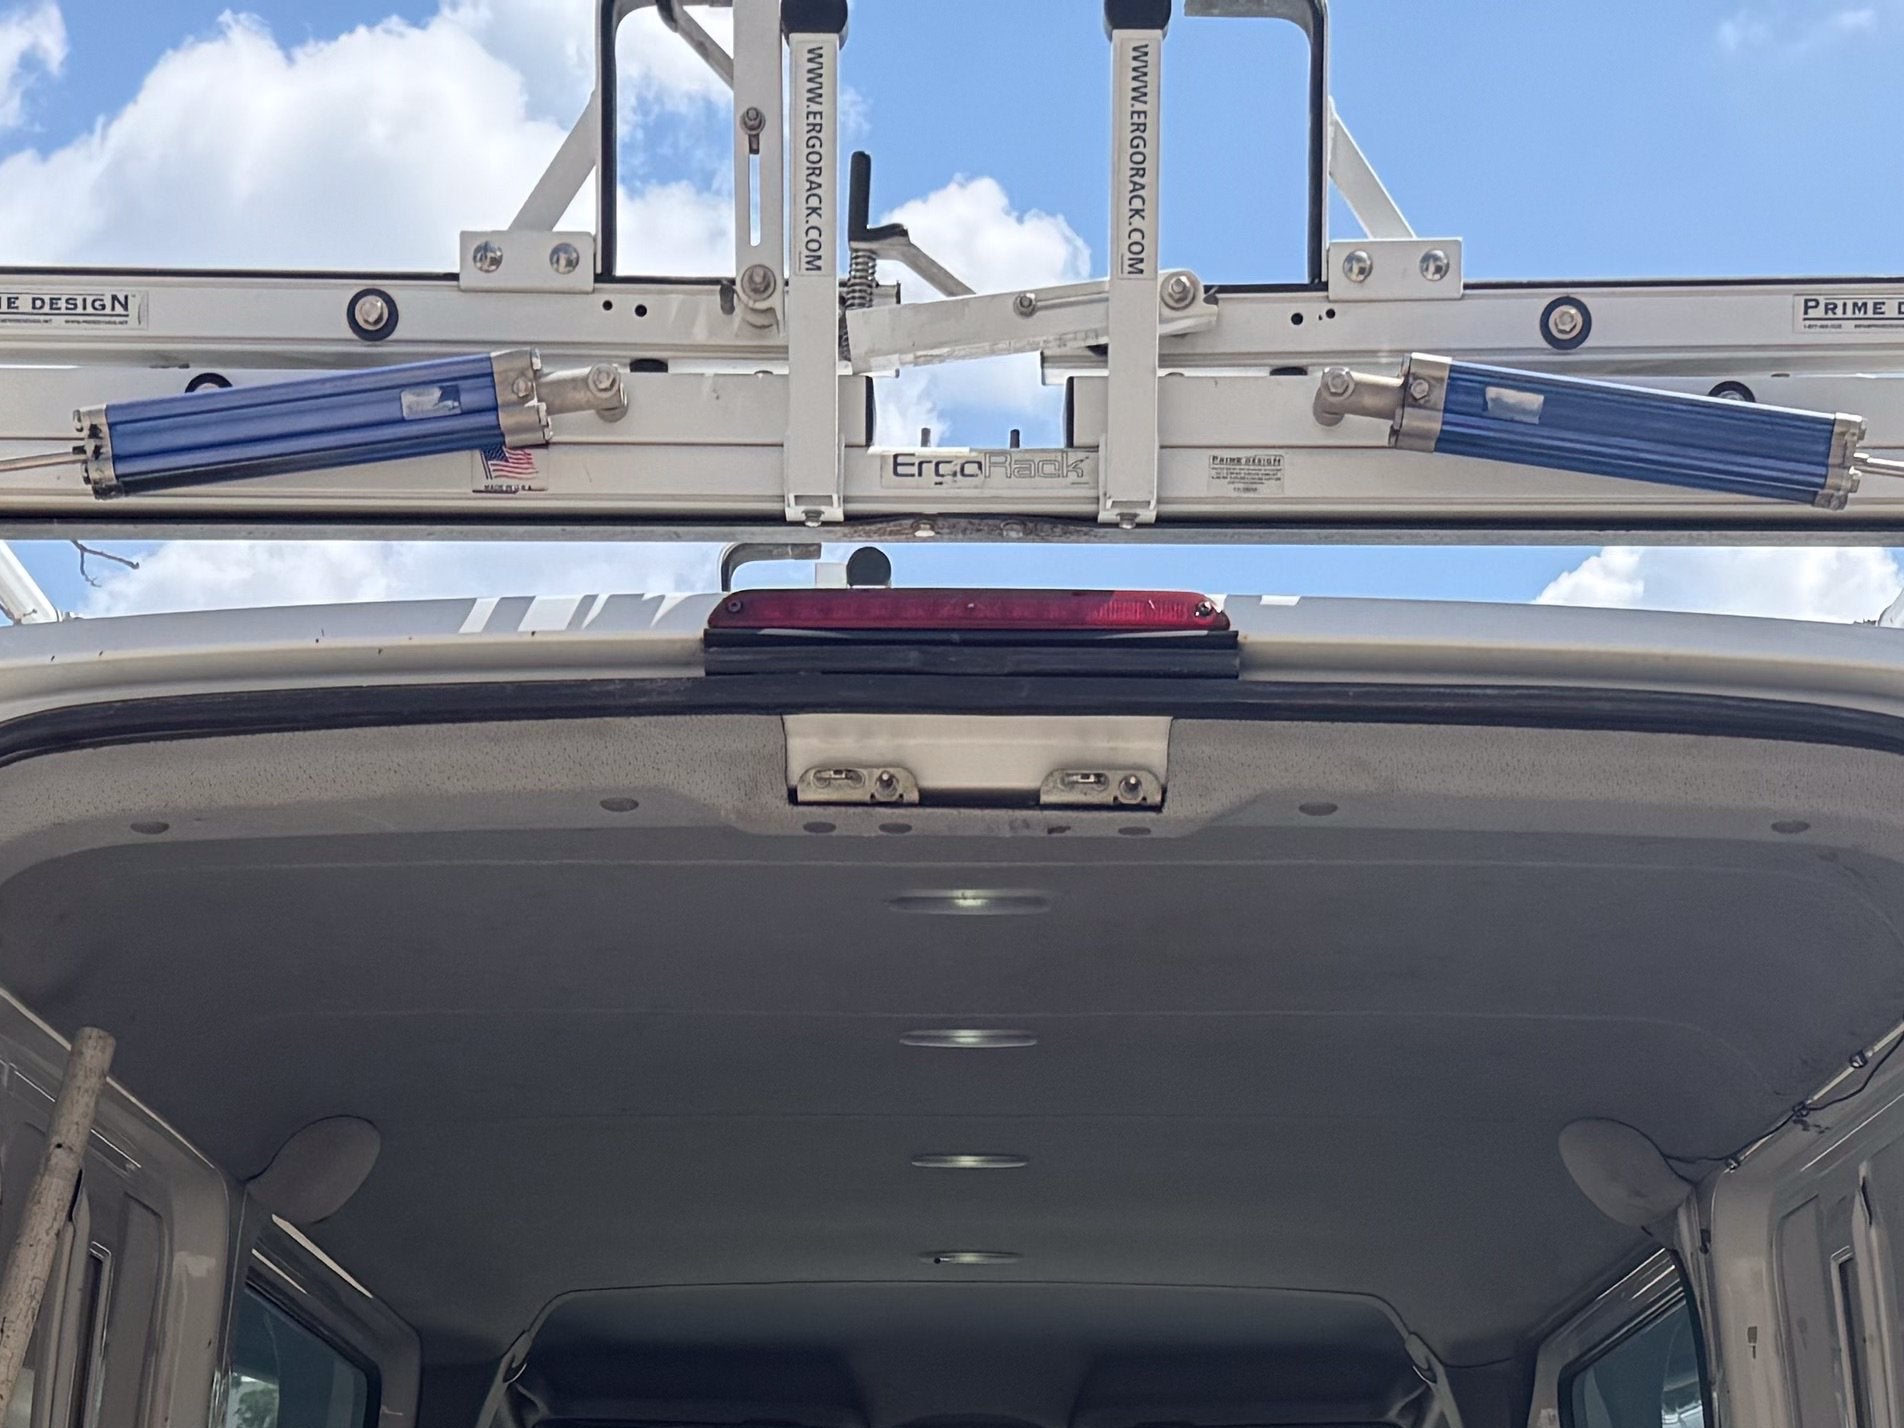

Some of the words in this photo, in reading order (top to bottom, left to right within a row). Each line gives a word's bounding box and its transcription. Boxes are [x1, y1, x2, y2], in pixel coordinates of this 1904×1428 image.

[805, 46, 824, 272] WWW.ERGORACK.COM
[1127, 44, 1149, 275] WWW.ERGORACK.COM
[31, 294, 129, 312] DESIGN
[1803, 298, 1886, 315] PRIME
